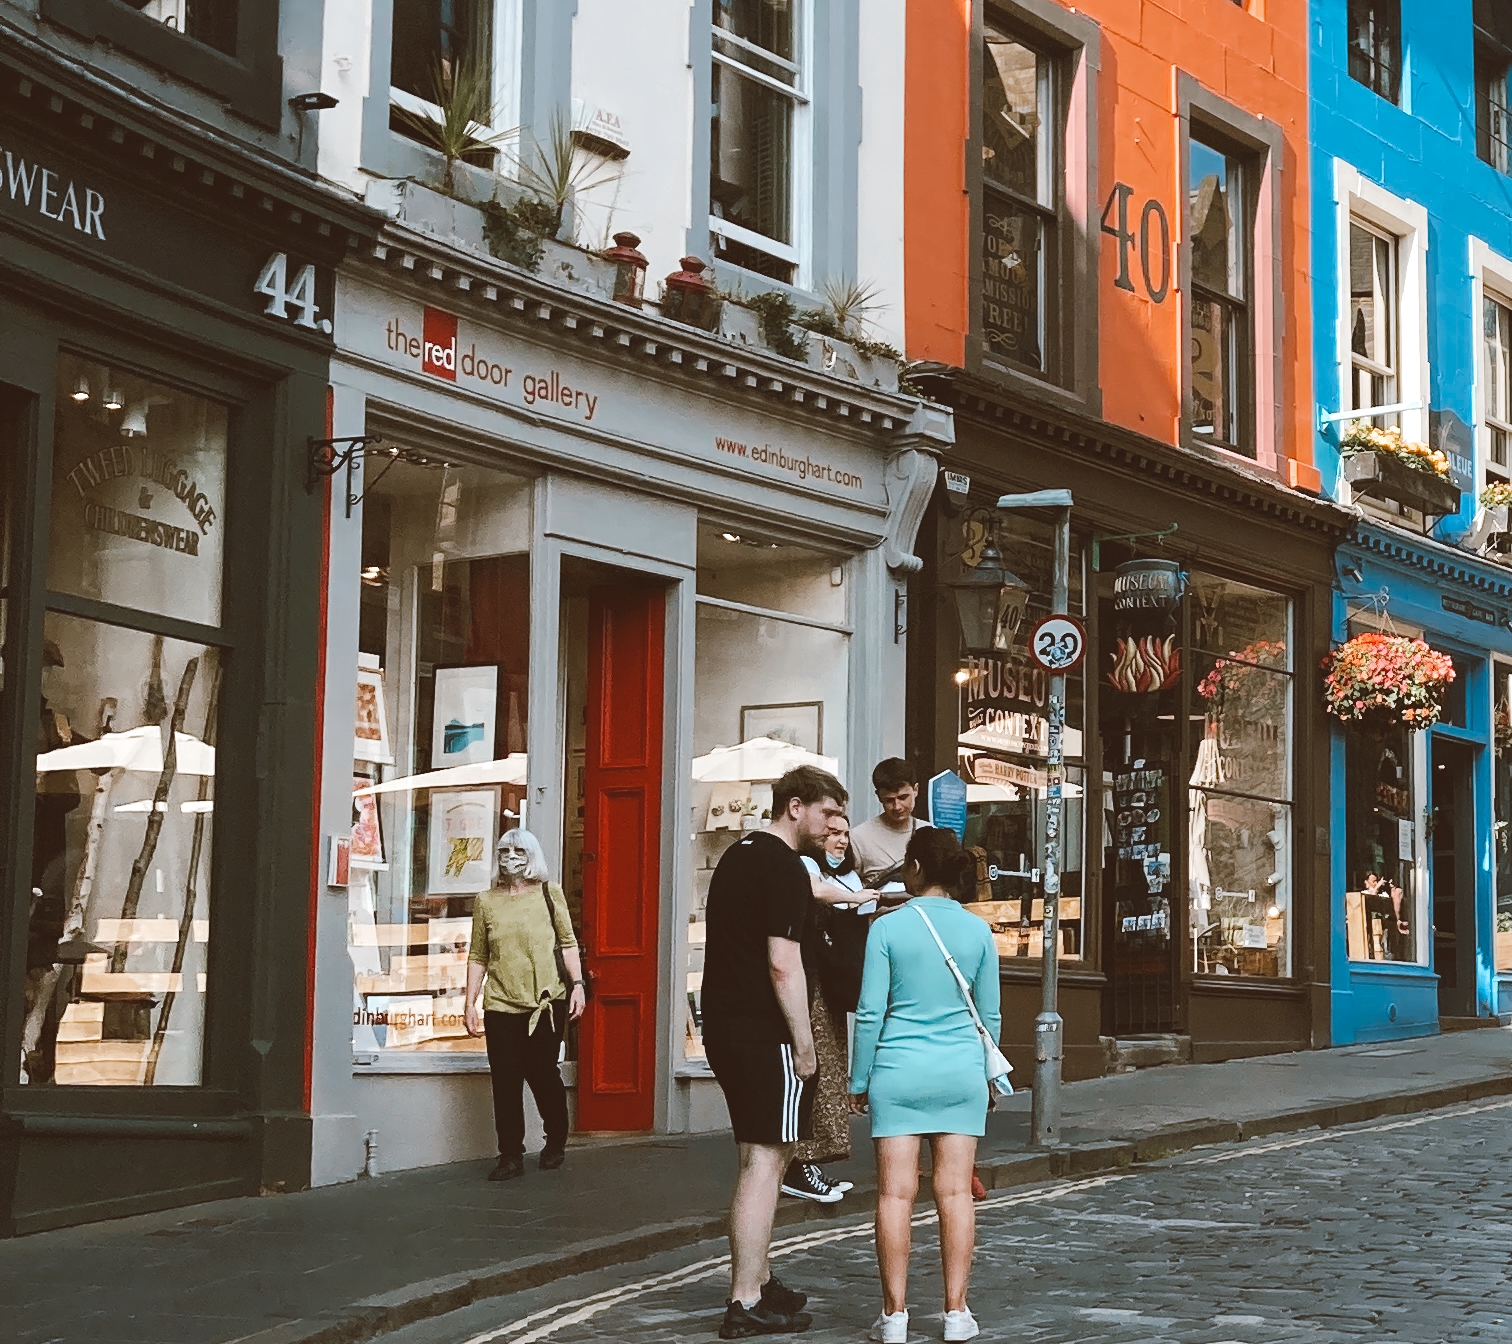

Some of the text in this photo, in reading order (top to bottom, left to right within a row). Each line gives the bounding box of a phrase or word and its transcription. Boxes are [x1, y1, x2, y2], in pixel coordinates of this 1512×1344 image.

[1100, 181, 1170, 304] 40
[385, 317, 598, 421] the red door gallery
[714, 435, 863, 490] www.edinburghart.com
[66, 445, 216, 536] TWEED LUGGAGE
[84, 502, 199, 557] CHILDRENSWEAR
[1114, 572, 1170, 594] MUSEUM
[1114, 595, 1168, 611] CONTEXT
[1000, 604, 1018, 630] 40
[1038, 631, 1079, 666] 20
[985, 707, 1049, 742] CONTEXT
